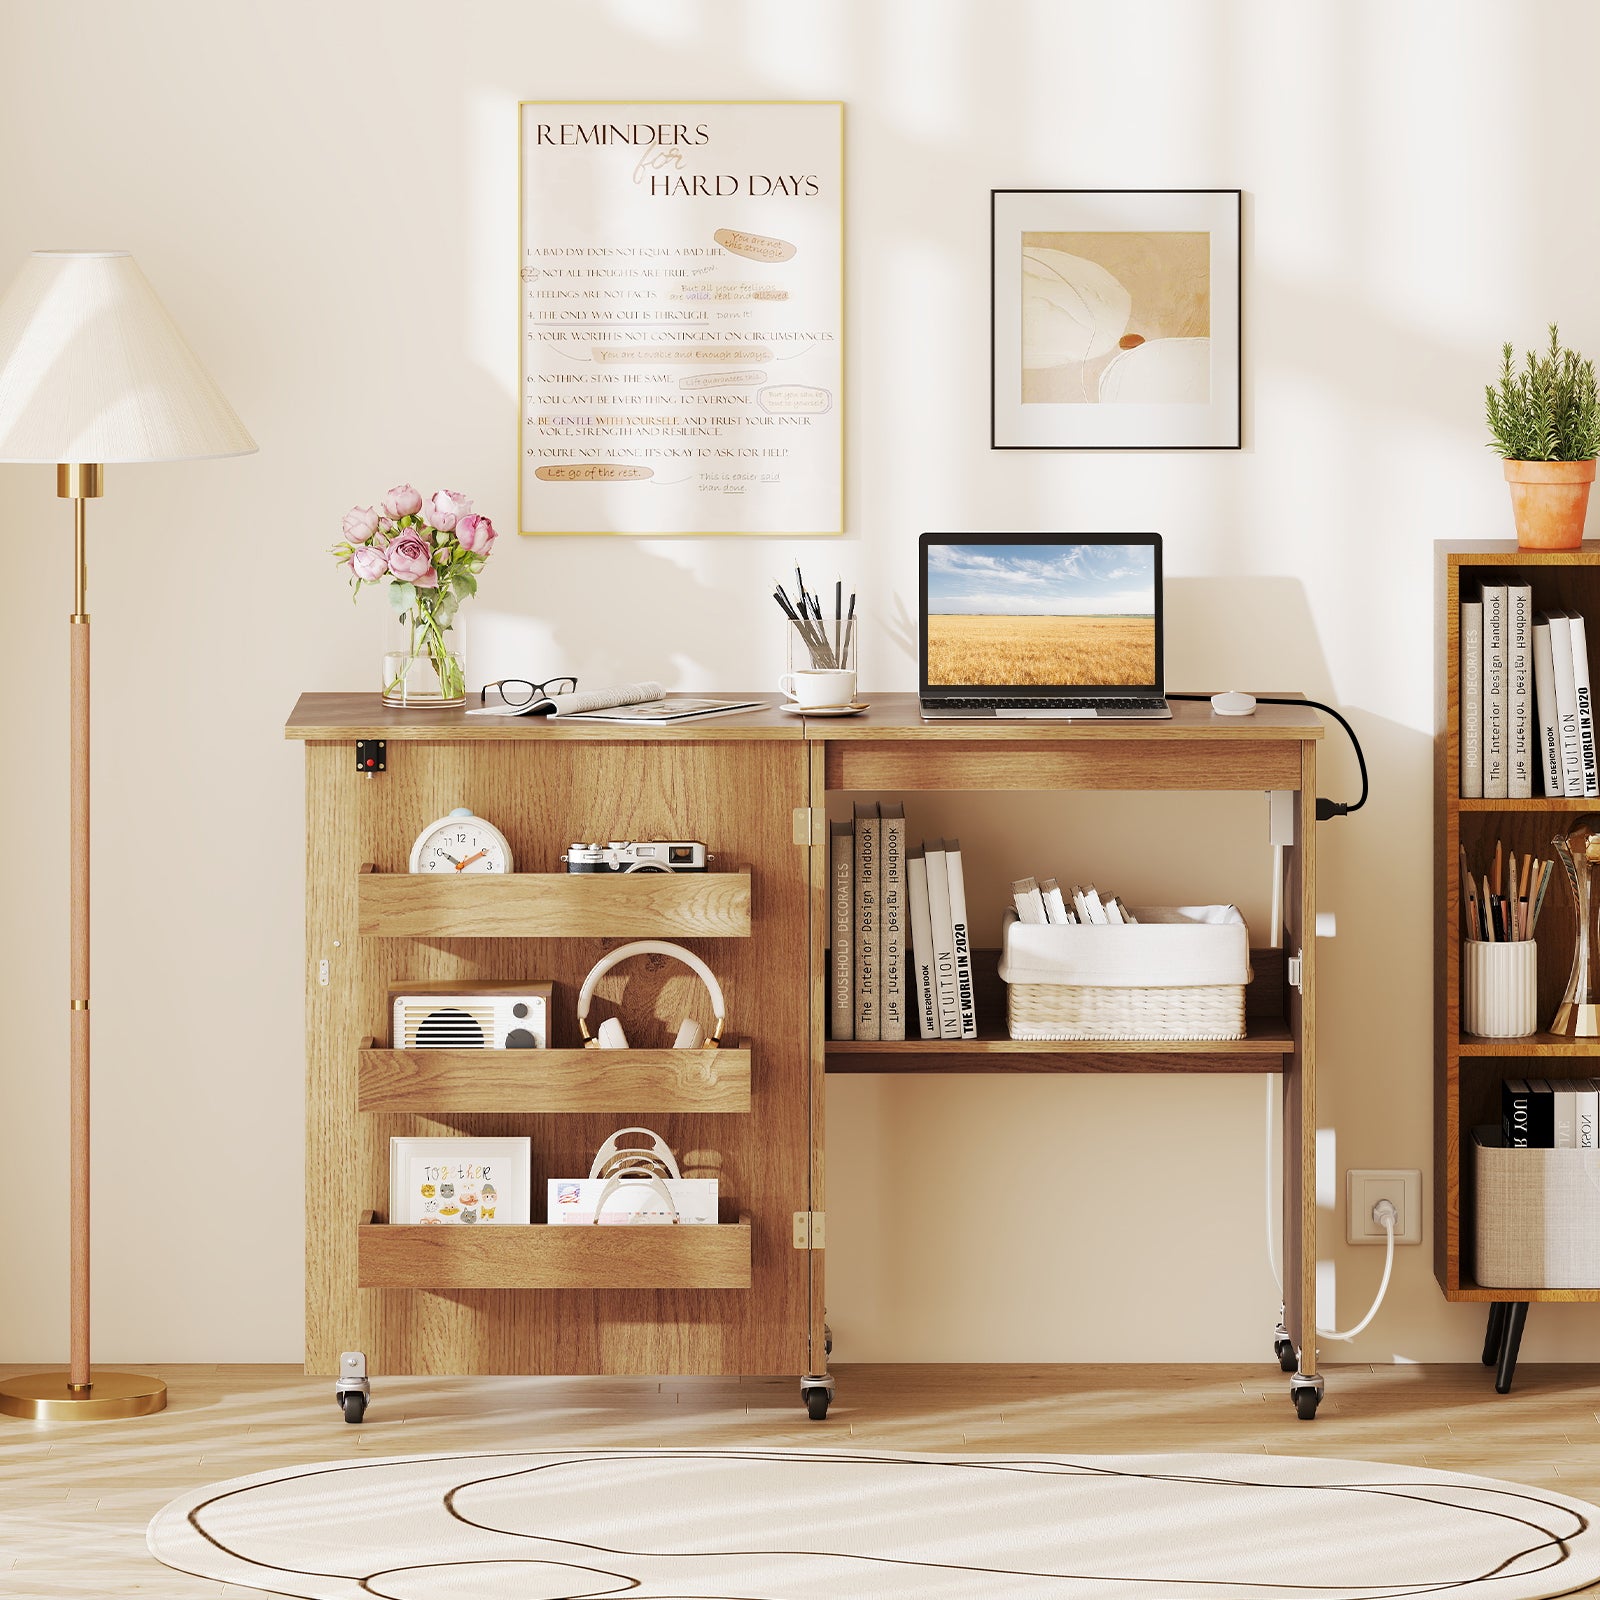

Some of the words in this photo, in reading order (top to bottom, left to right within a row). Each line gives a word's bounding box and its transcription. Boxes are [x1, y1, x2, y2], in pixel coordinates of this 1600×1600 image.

[537, 124, 709, 146] REMINDERS
[633, 141, 687, 184] for
[651, 175, 738, 196] HARD
[748, 175, 819, 196] DAYS
[724, 241, 742, 250] this
[732, 233, 749, 243] You
[767, 240, 782, 248] not
[532, 248, 540, 256] A
[544, 248, 563, 256] BAD
[566, 248, 584, 256] DAY
[588, 248, 613, 256] DOES
[616, 248, 635, 256] NOT
[640, 248, 670, 257] EQUAL
[675, 248, 681, 256] A
[684, 248, 703, 256] BAD
[543, 269, 562, 277] NOT
[567, 269, 581, 277] ALL
[587, 269, 638, 277] THOUGHTS
[642, 269, 660, 277] ARE
[539, 311, 556, 319] THE
[560, 311, 588, 319] ONLY
[592, 311, 613, 319] WAY
[616, 311, 638, 319] OUT
[643, 311, 651, 319] IS
[538, 332, 567, 341] YOUR
[571, 332, 611, 341] WORTH
[613, 332, 622, 341] IS
[625, 332, 647, 341] NOT
[651, 332, 721, 341] CONTINGENT
[725, 332, 742, 341] ON
[538, 375, 588, 383] NOTHING
[591, 375, 619, 383] STAYS
[623, 375, 642, 383] THE
[538, 396, 559, 404] YOU
[597, 396, 610, 404] BE
[612, 396, 677, 404] EVERYTHING
[681, 396, 695, 404] TO
[538, 417, 548, 425] BE
[553, 417, 592, 425] GENTLE
[595, 417, 623, 425] WITH
[683, 417, 706, 425] AND
[711, 417, 742, 425] TRUST
[746, 417, 773, 425] YOUR
[779, 417, 811, 425] INNER
[576, 428, 632, 436] STRENGTH
[636, 428, 659, 436] AND
[579, 449, 600, 457] NOT
[664, 449, 693, 457] OKAY
[698, 449, 710, 457] TO
[715, 449, 734, 457] ASK
[738, 449, 759, 457] FOR
[548, 469, 565, 477] Let
[569, 471, 581, 479] go
[585, 467, 596, 479] of
[599, 468, 615, 477] the
[618, 469, 641, 477] rest.
[699, 484, 720, 492] than
[1491, 595, 1500, 649] Handbook
[1467, 630, 1478, 694] DECORATES
[1491, 655, 1502, 695] Design
[1578, 687, 1590, 715] 2020
[1490, 702, 1500, 754] Interior
[1581, 718, 1591, 729] IN
[1467, 702, 1477, 767] HOUSEHOLD
[1563, 714, 1580, 792] INTUITION
[1582, 731, 1595, 770] WORLD
[1491, 761, 1500, 781] The
[1586, 771, 1596, 792] THE
[456, 834, 466, 843] 12
[430, 861, 435, 870] 9
[486, 861, 492, 870] 3
[862, 827, 872, 883] Handbook
[837, 863, 849, 932] DECORATES
[862, 889, 874, 932] Design
[954, 923, 967, 954] 2020
[862, 939, 872, 994] Interior
[957, 955, 968, 968] IN
[837, 939, 849, 1008] HOUSEHOLD
[939, 951, 957, 1033] INTUITION
[959, 969, 972, 1012] WORLD
[861, 1001, 872, 1023] The
[963, 1012, 974, 1034] THE
